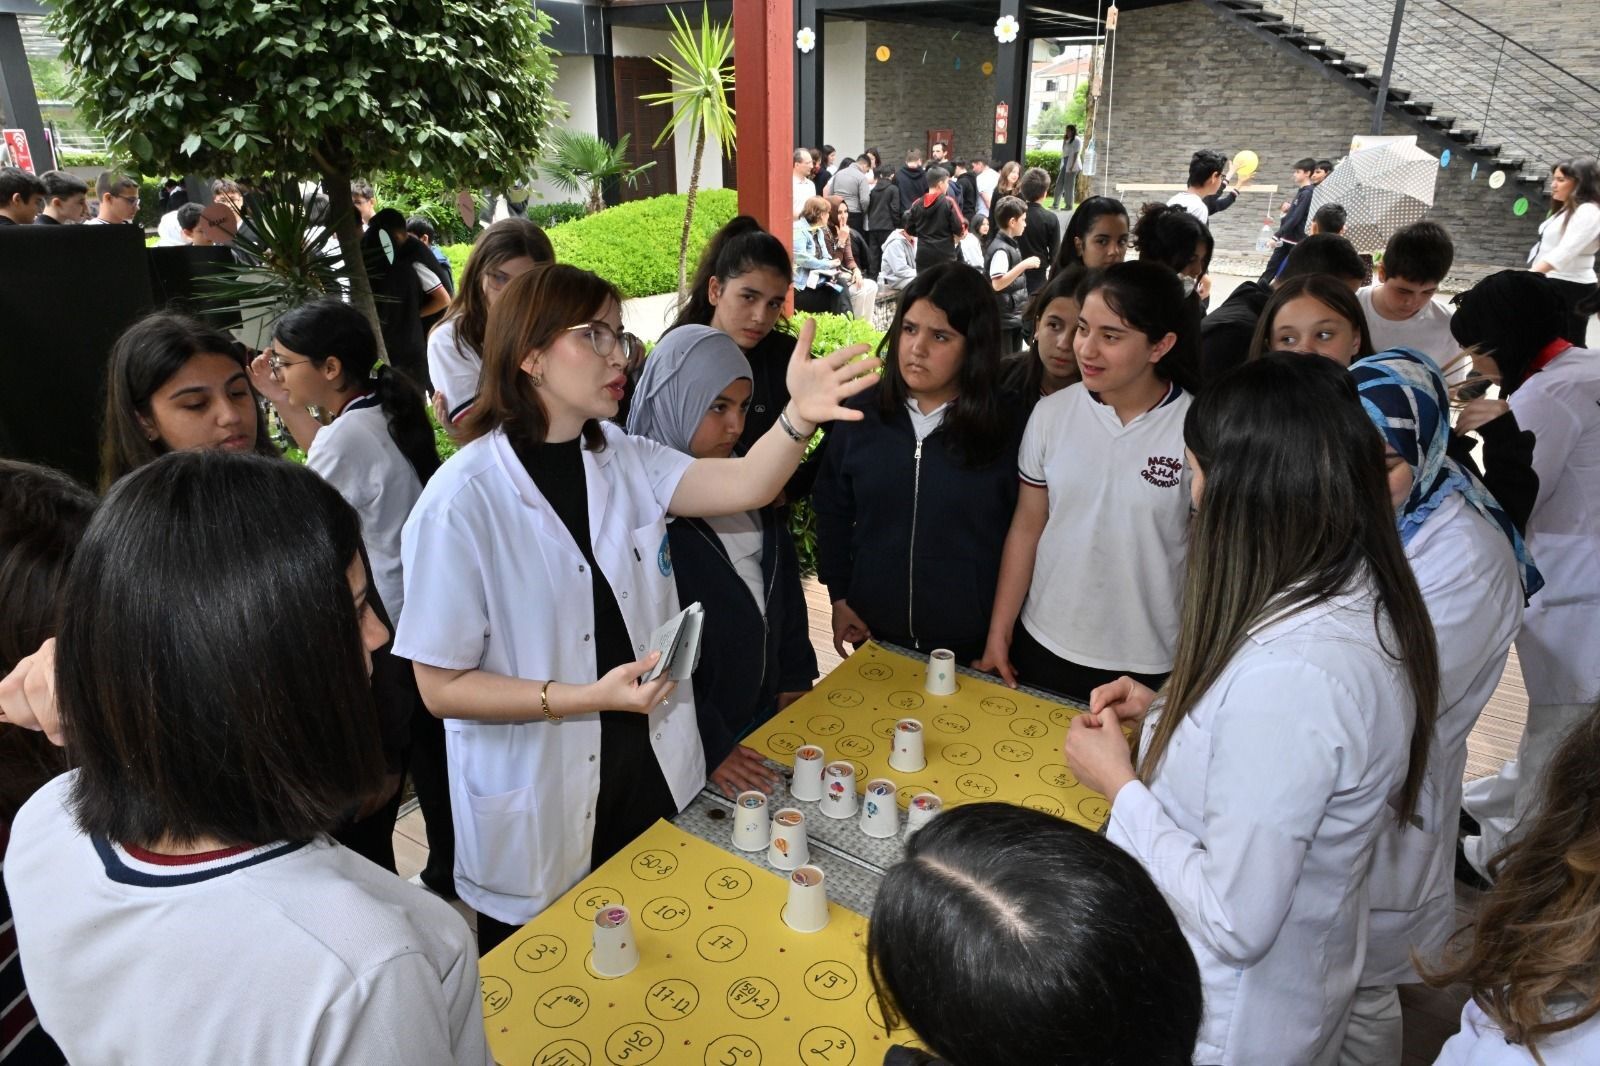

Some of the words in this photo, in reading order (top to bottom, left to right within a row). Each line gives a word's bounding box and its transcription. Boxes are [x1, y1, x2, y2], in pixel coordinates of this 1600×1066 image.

[640, 854, 673, 875] 50-8
[717, 875, 739, 890] 50
[708, 935, 734, 950] 17
[652, 986, 690, 1014] 17-12
